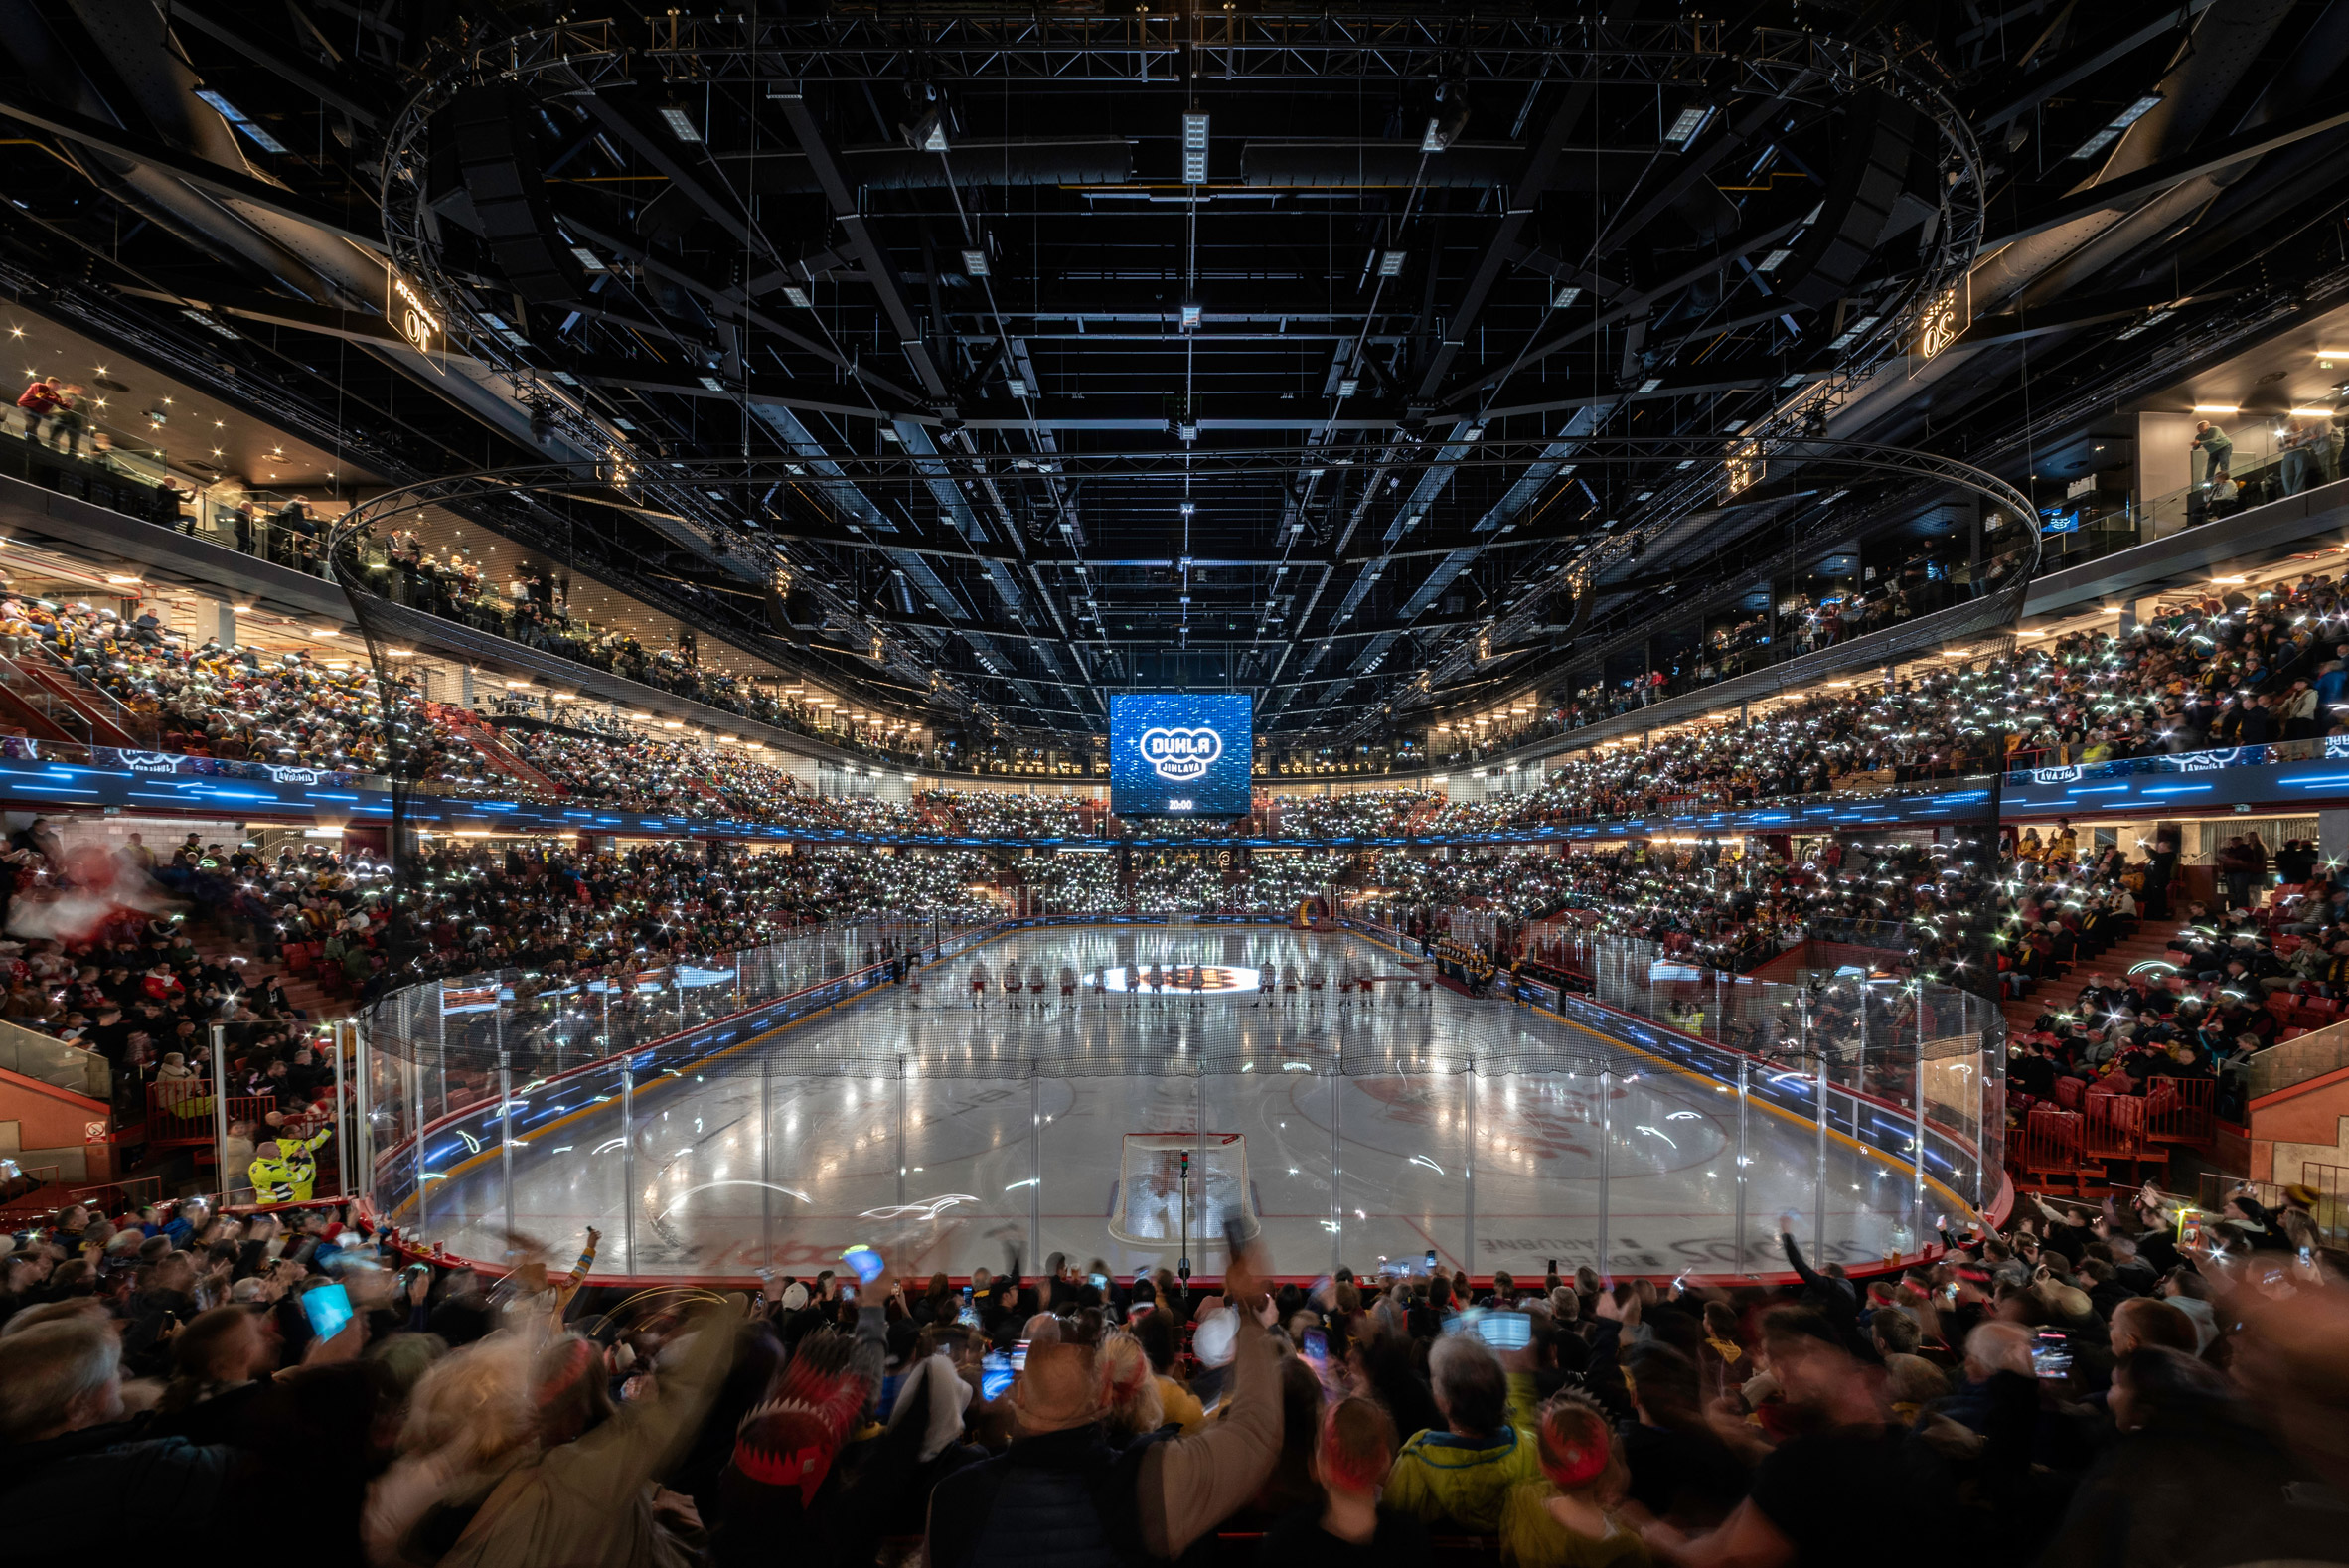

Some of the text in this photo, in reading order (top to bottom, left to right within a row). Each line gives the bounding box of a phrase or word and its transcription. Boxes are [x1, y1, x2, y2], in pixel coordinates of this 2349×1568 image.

[1152, 738, 1210, 754] DUKLA
[1162, 763, 1200, 773] JIHLAVA
[1169, 800, 1192, 810] 20:00
